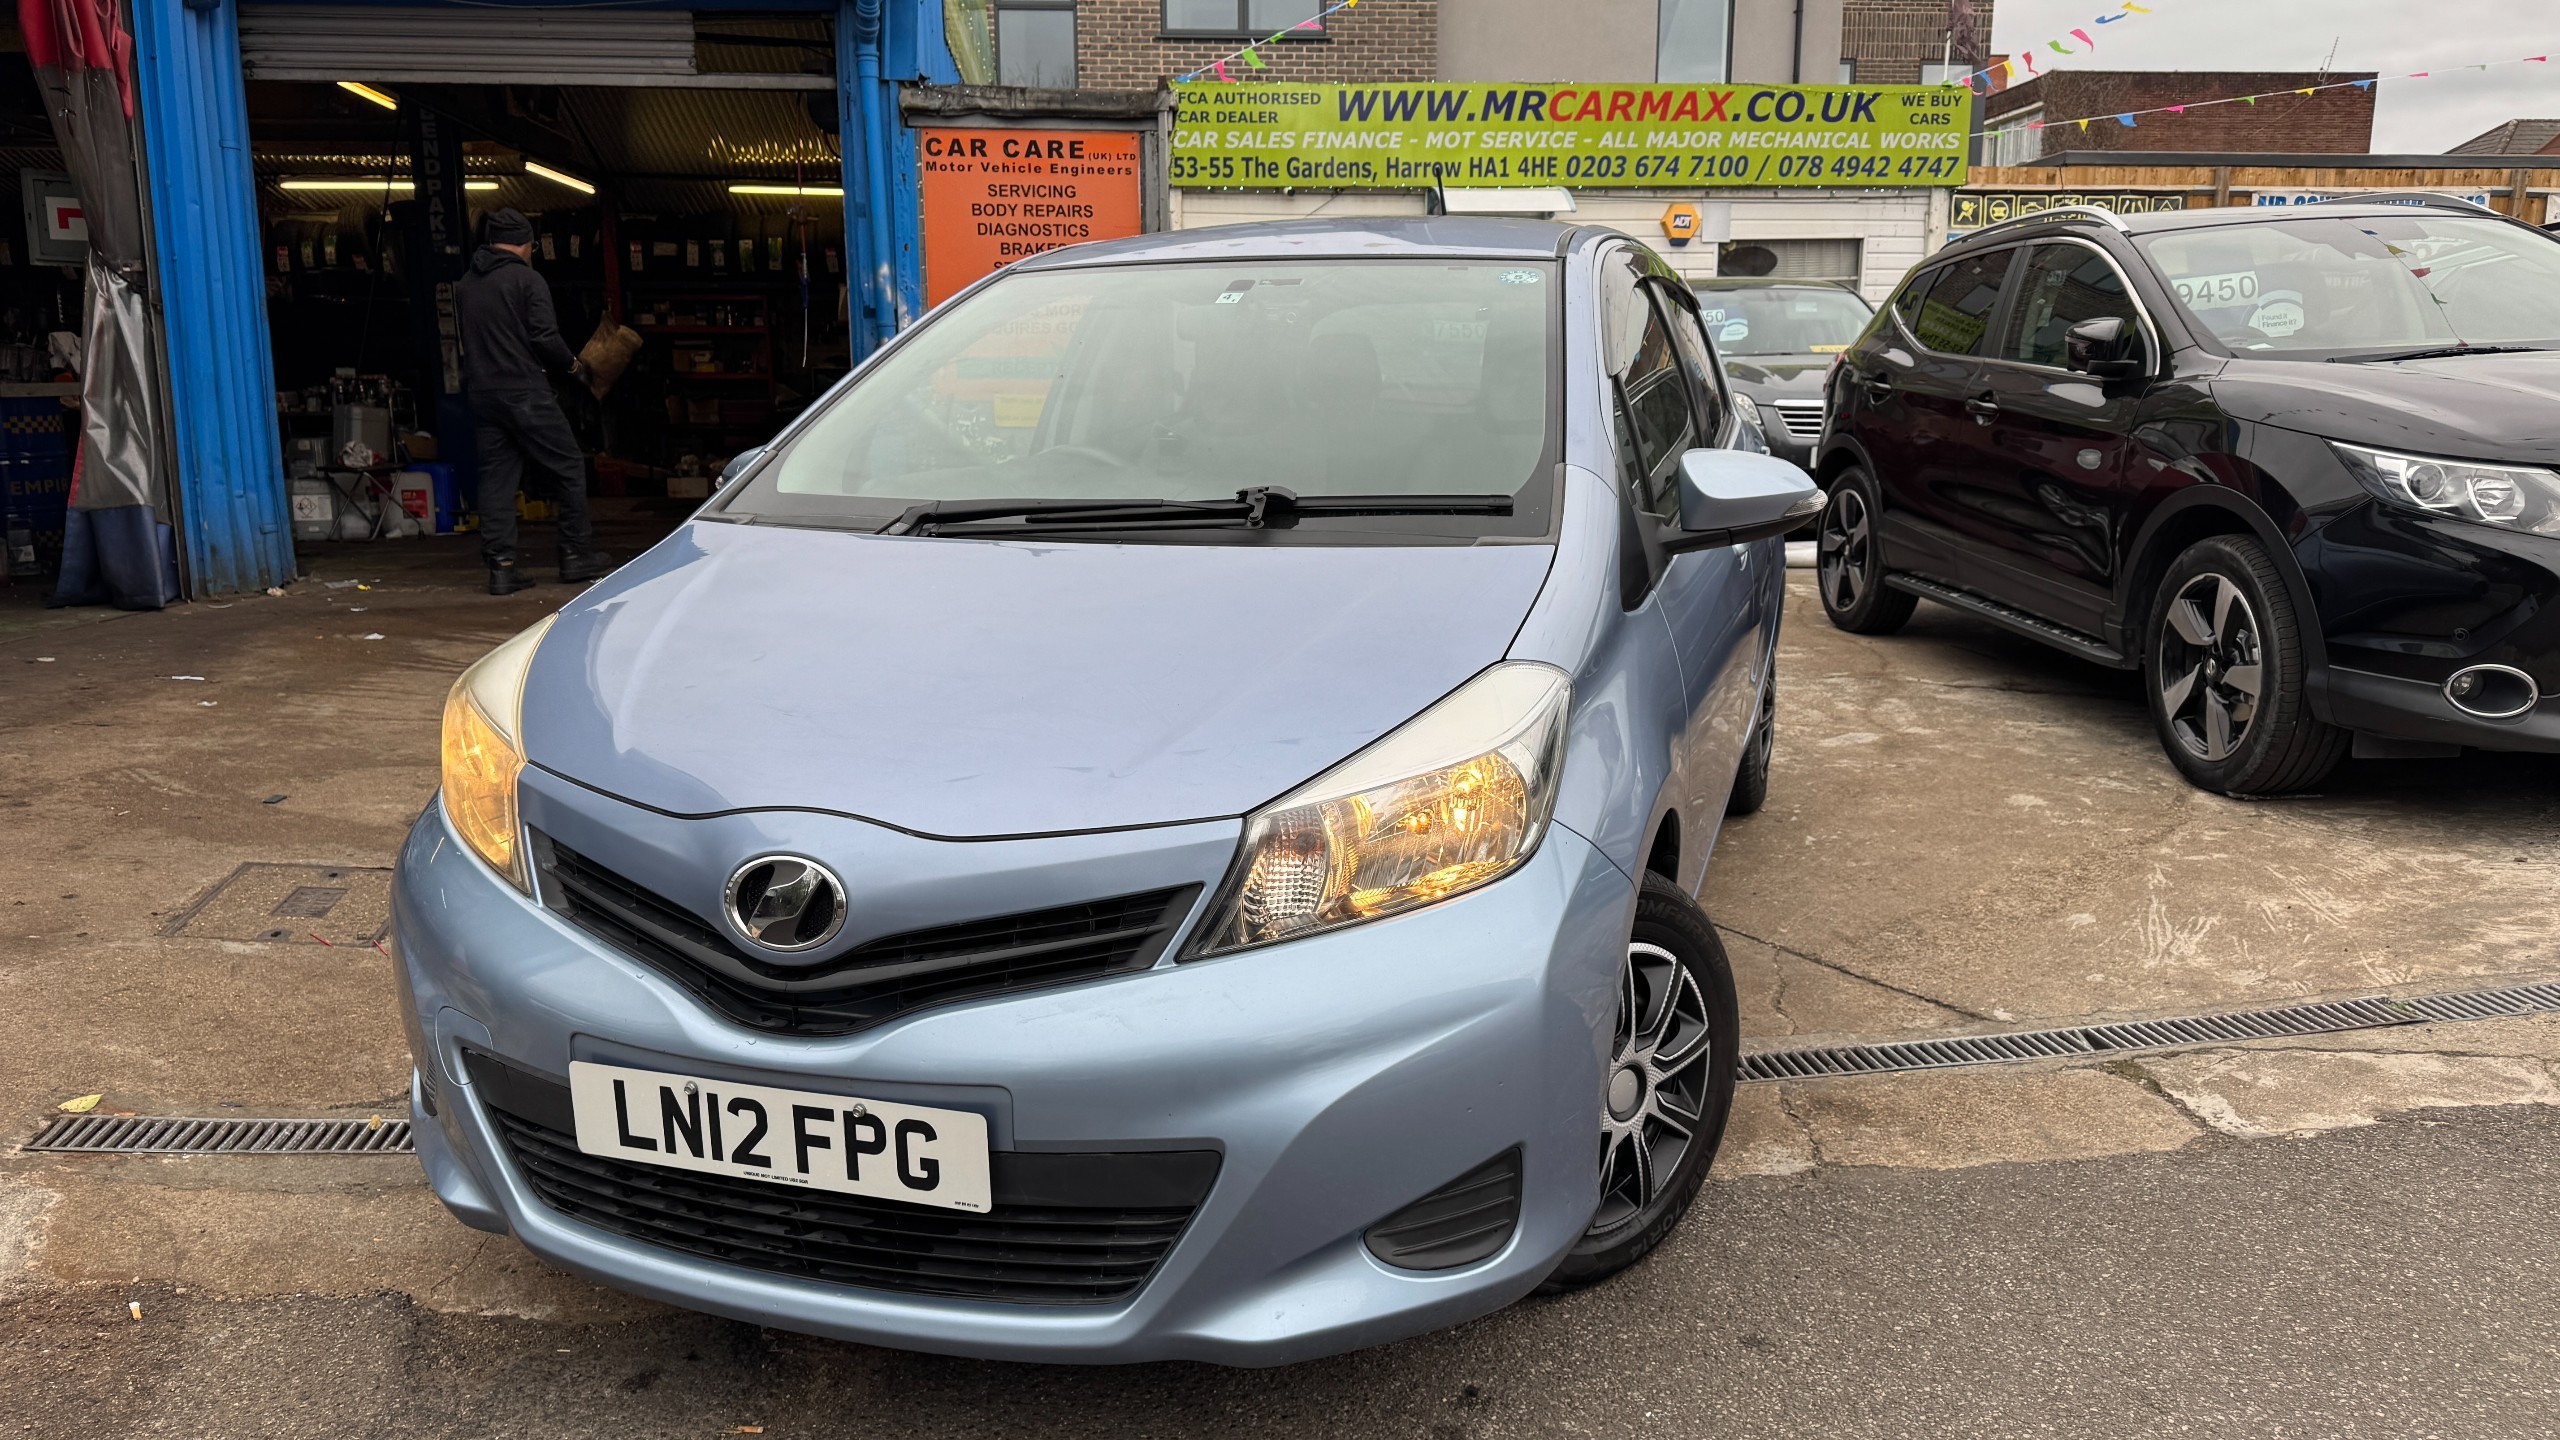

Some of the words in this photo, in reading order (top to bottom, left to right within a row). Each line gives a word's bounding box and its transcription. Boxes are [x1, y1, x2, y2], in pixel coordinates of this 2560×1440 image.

[1178, 92, 1208, 105] FCA
[1213, 92, 1322, 105] AUTHORISED
[1902, 95, 1930, 107] WE
[1931, 95, 1963, 107] BUY
[1338, 90, 1883, 123] WWW.MRCARMAX.CO.UK
[1178, 111, 1211, 123] CAR
[1216, 111, 1279, 124] DEALER
[1910, 113, 1951, 125] CARS
[1173, 131, 1218, 149] CAR
[1225, 131, 1296, 149] SALES
[1302, 131, 1403, 149] FINANCE
[1425, 131, 1476, 149] MOT
[1480, 131, 1578, 149] SERVICE
[1598, 131, 1639, 149] ALL
[1645, 131, 1723, 149] MAJOR
[1728, 131, 1872, 149] MECHANICAL
[1880, 132, 1961, 149] WORKS
[925, 137, 988, 157] CAR
[1002, 139, 1085, 159] CARE
[1088, 152, 1112, 162] (UK)
[1116, 153, 1137, 161] LTD
[925, 161, 973, 172] Motor
[980, 162, 1042, 174] Vehicle
[1050, 163, 1133, 177] Engineers
[1173, 156, 1235, 179] 53-55
[1241, 156, 1280, 179] The
[1286, 156, 1378, 183] Gardens,
[1386, 156, 1462, 178] Harrow
[1469, 156, 1510, 178] HA1
[1518, 156, 1558, 178] 4HE
[1566, 155, 1627, 178] 0203
[1634, 155, 1681, 178] 674
[1688, 155, 1749, 178] 7100
[1755, 155, 1771, 182] /
[1778, 155, 1824, 178] 078
[1831, 155, 1891, 178] 4942
[1898, 156, 1960, 178] 4747
[987, 184, 1077, 198] SERVICING
[971, 203, 1018, 217] BODY
[1023, 204, 1094, 218] REPAIRS
[1672, 214, 1692, 229] ADT
[977, 222, 1090, 237] DIAGNOSTICS
[612, 1079, 772, 1169] LN12
[791, 1104, 941, 1192] FPG
